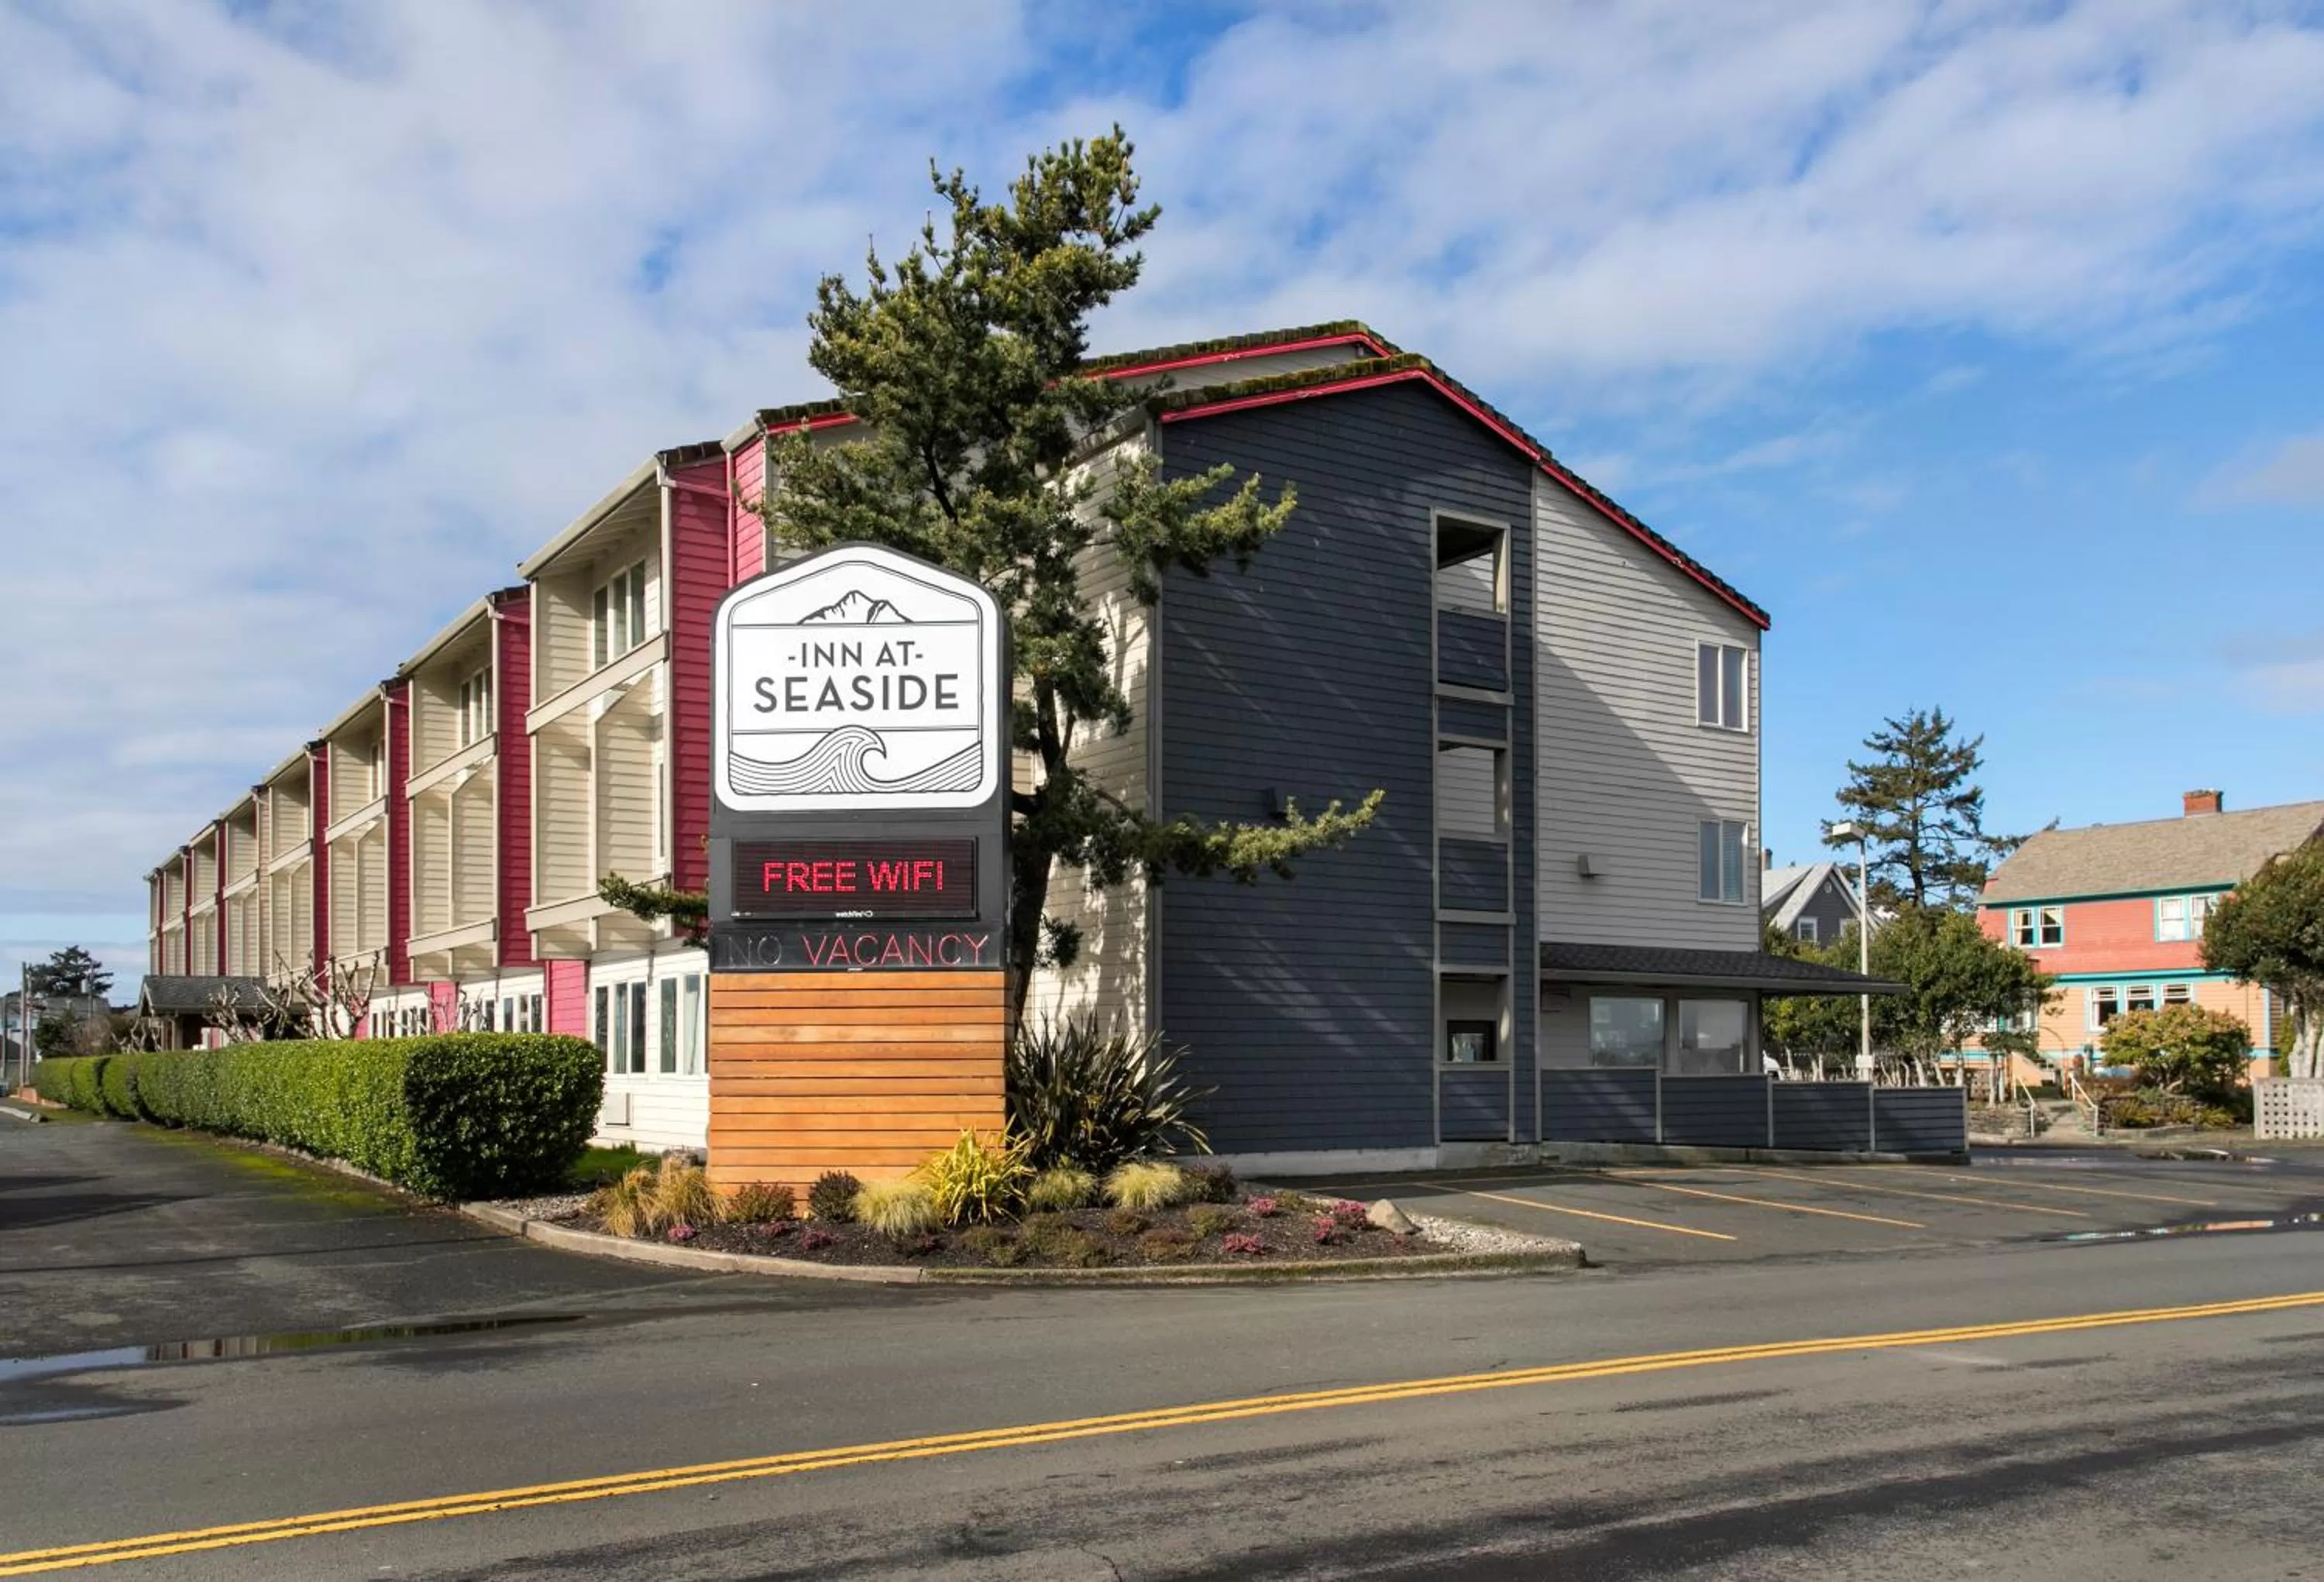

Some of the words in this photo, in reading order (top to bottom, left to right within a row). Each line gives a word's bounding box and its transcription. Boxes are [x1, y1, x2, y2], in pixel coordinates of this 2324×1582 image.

[753, 673, 960, 714] SEASIDE
[761, 861, 856, 892] FREE
[867, 860, 944, 892] WIFI
[727, 934, 782, 968] NO
[801, 933, 990, 968] VACANCY
